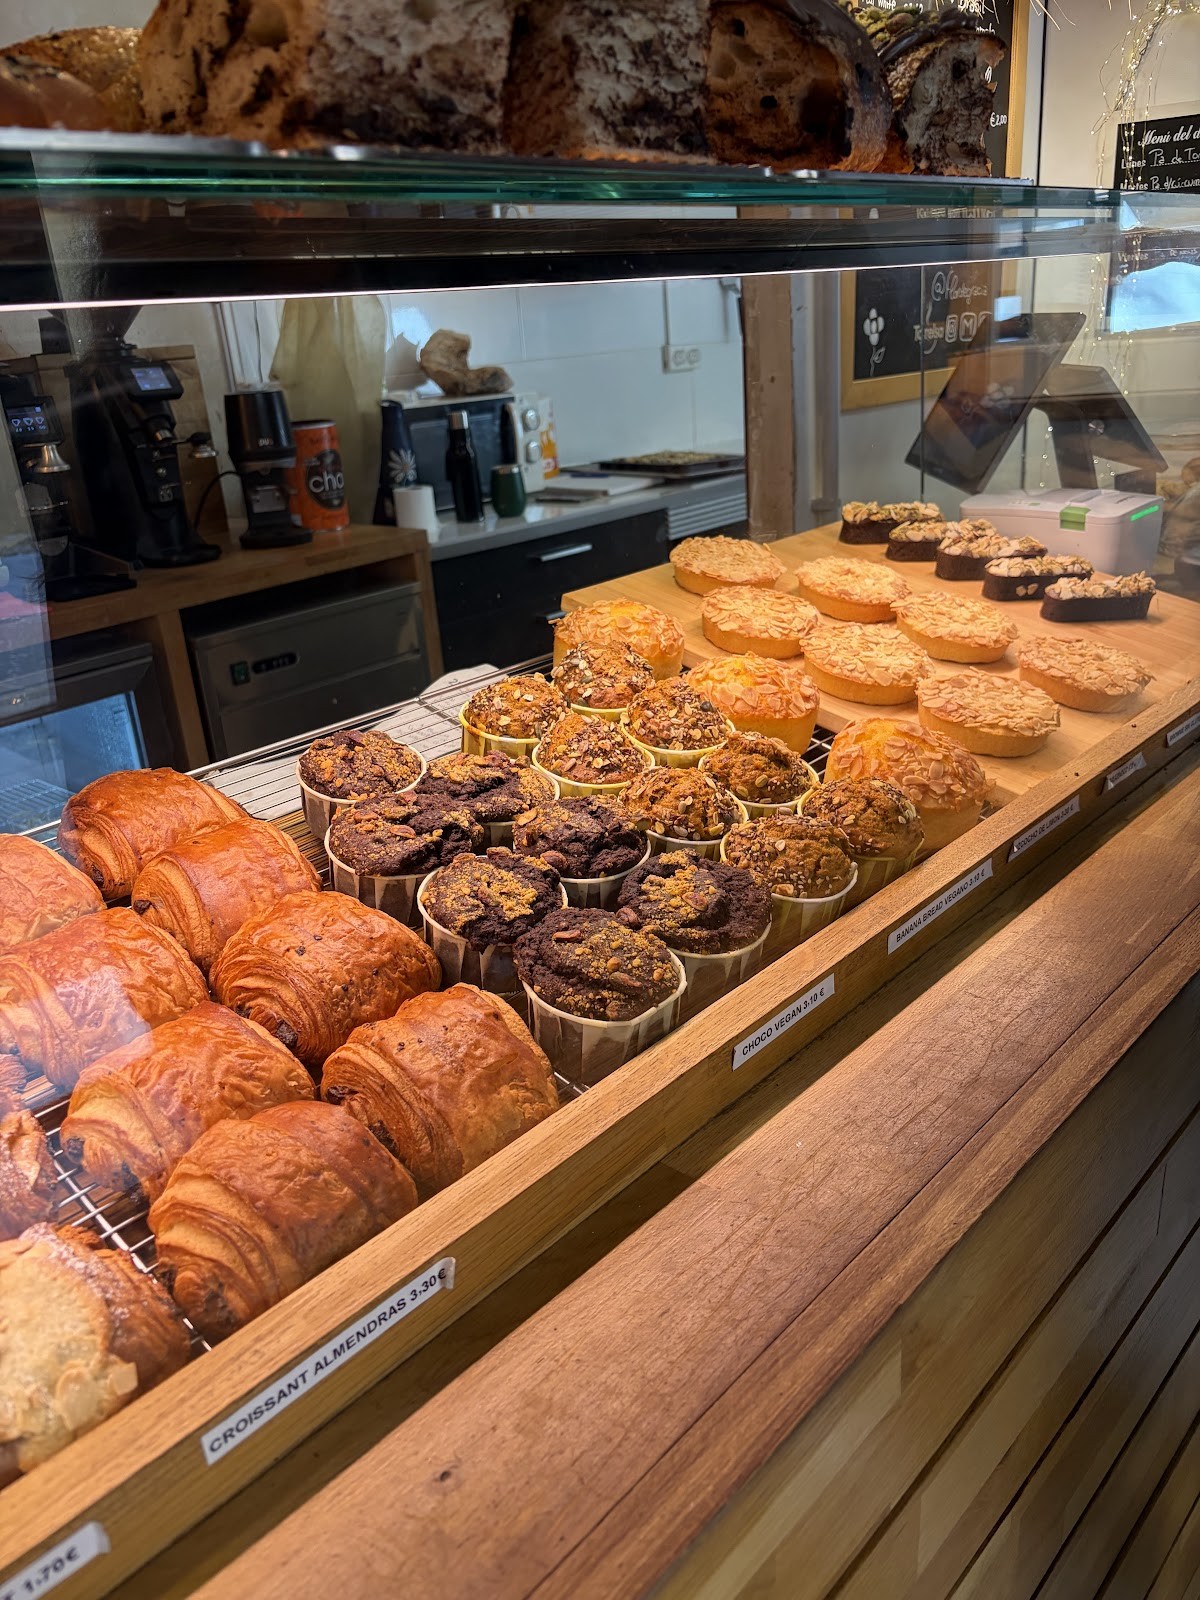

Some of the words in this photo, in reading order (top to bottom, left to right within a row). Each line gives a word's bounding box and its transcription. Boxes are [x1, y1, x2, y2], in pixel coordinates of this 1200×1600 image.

[1173, 125, 1194, 142] del
[895, 916, 923, 943] BANANA
[922, 900, 944, 923] BREAD
[943, 881, 969, 907] VEGANO
[742, 1027, 774, 1056] CHOCO
[773, 1004, 802, 1031] VEGAN
[819, 986, 825, 998] €
[208, 1371, 310, 1454] CROISSANT
[313, 1298, 408, 1376] ALMENDRAS
